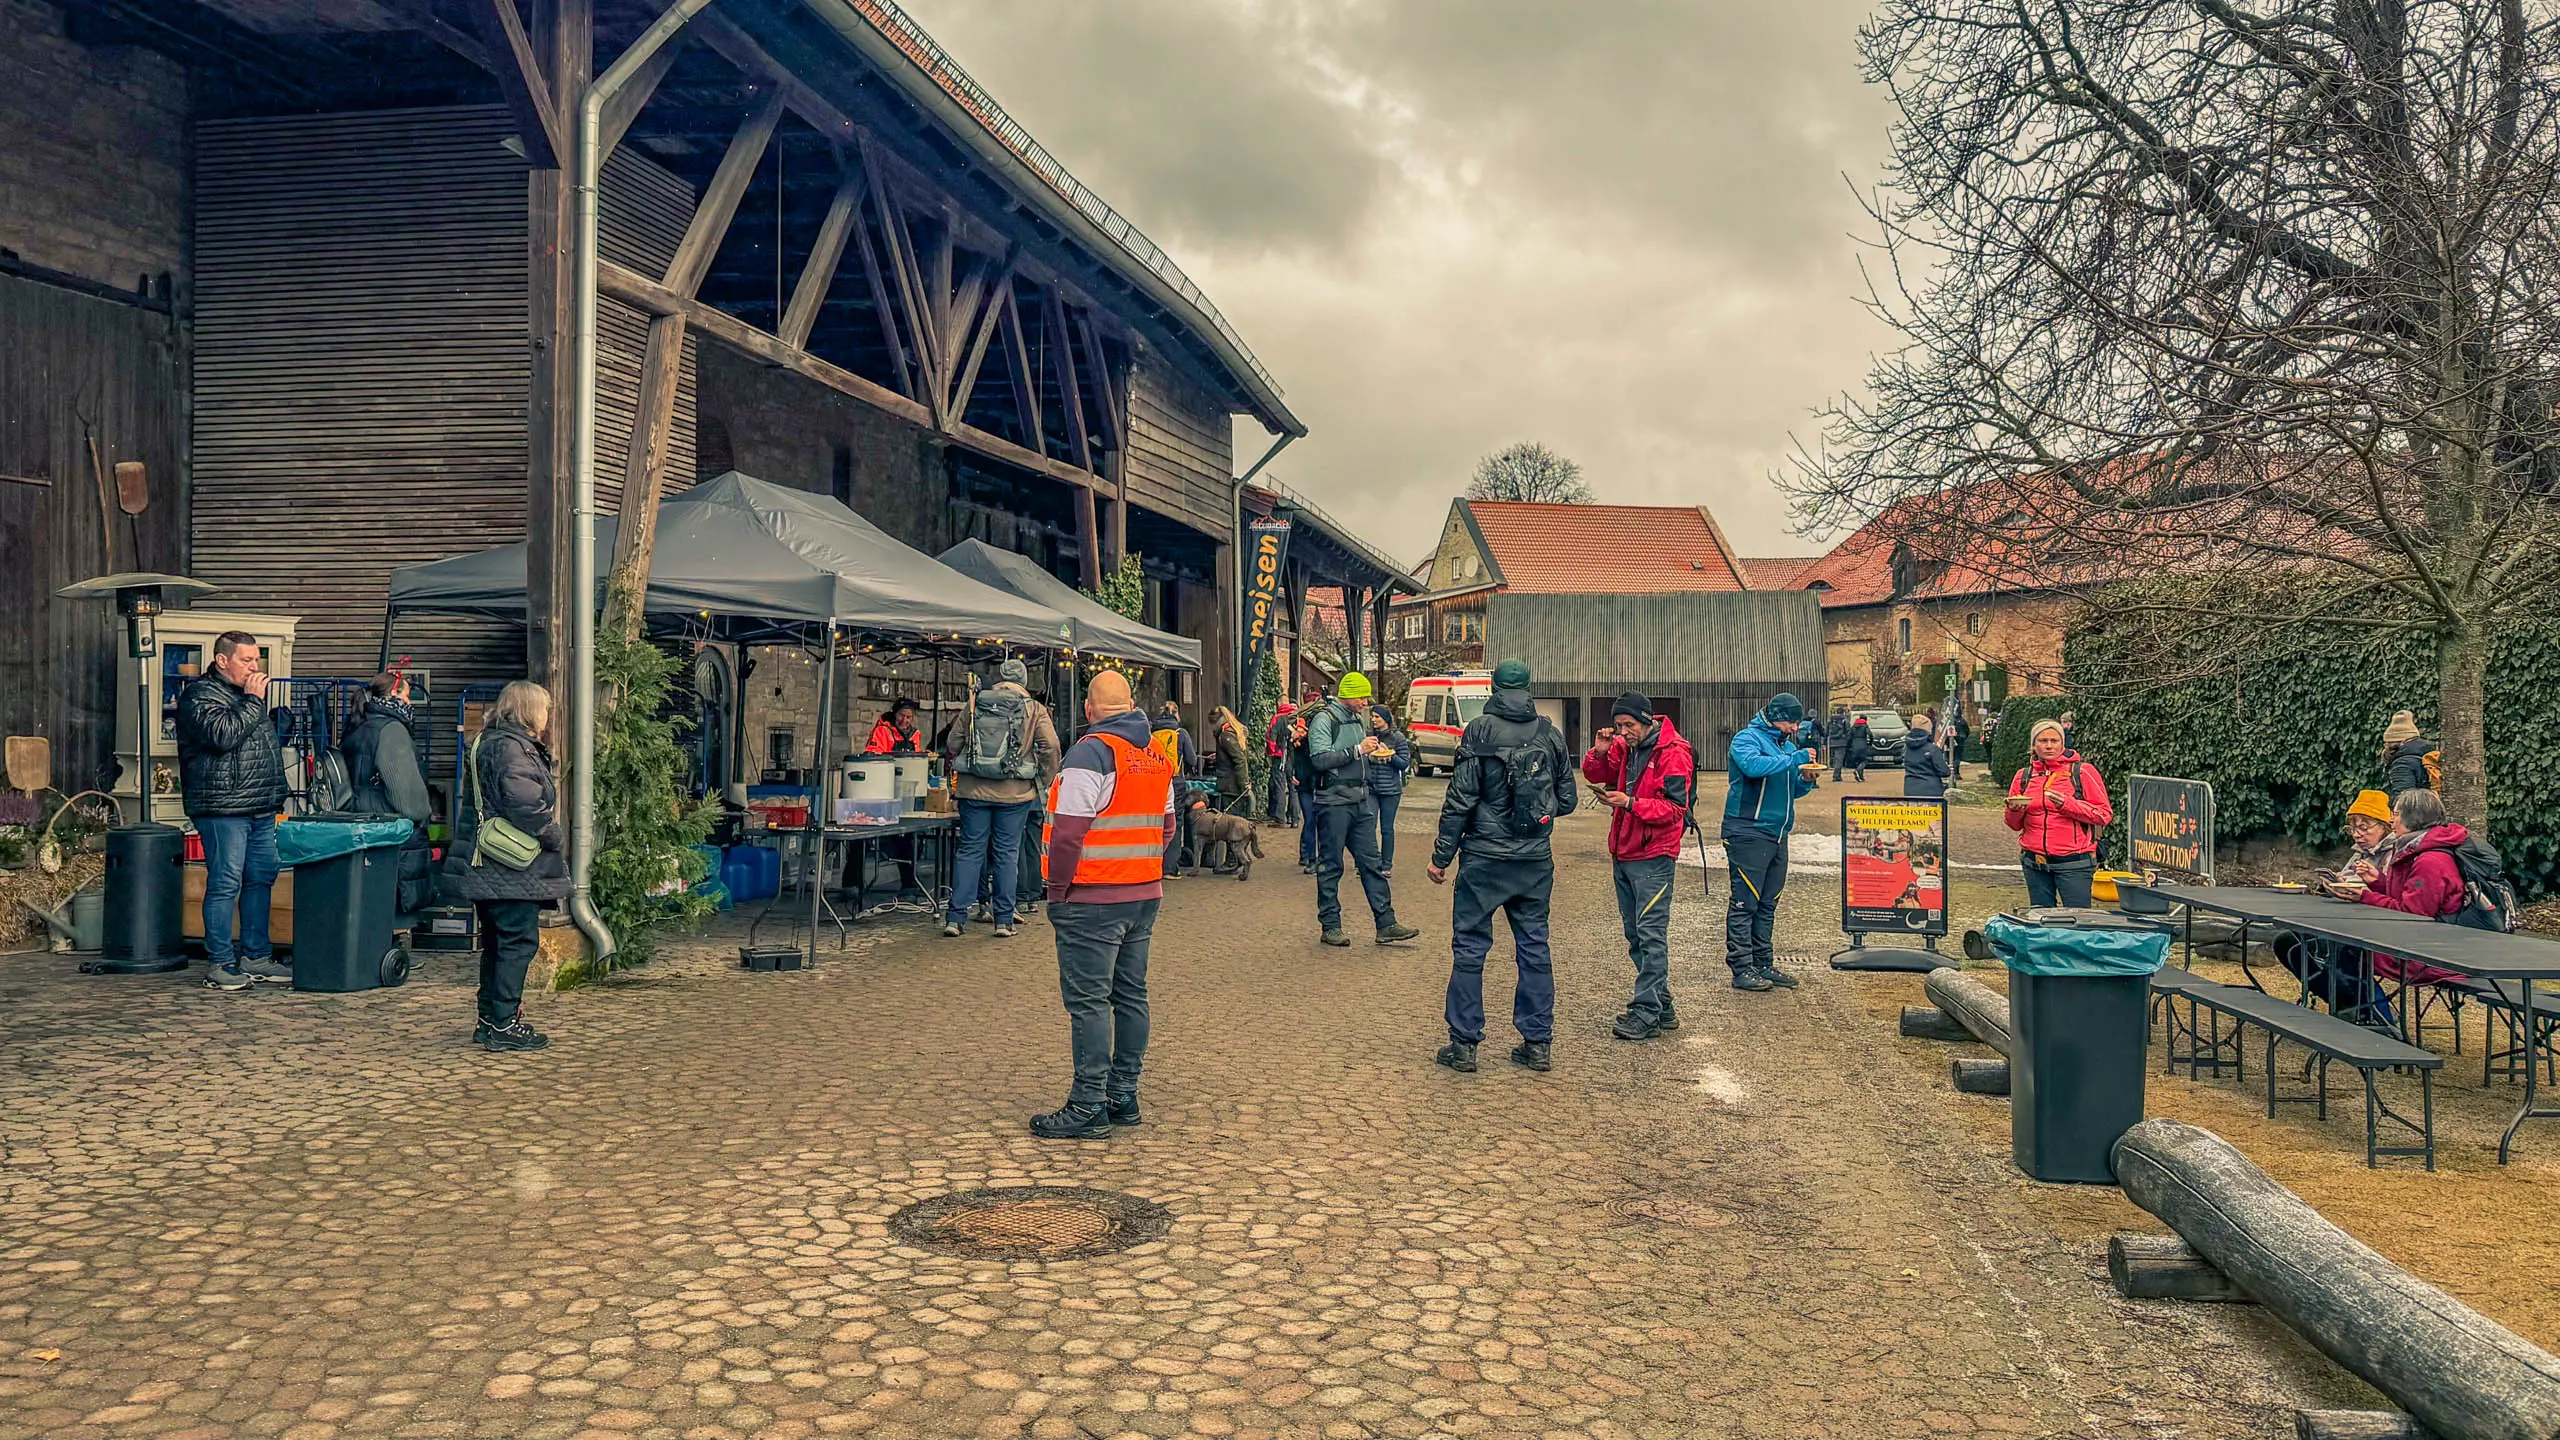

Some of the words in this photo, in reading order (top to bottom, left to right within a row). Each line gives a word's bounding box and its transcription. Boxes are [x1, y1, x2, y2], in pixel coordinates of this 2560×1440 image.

[1850, 807, 1879, 815] WERDE
[1901, 809, 1938, 817] UNSERES
[2145, 811, 2178, 839] HUNDE
[2135, 840, 2191, 869] TRINKSTATION
